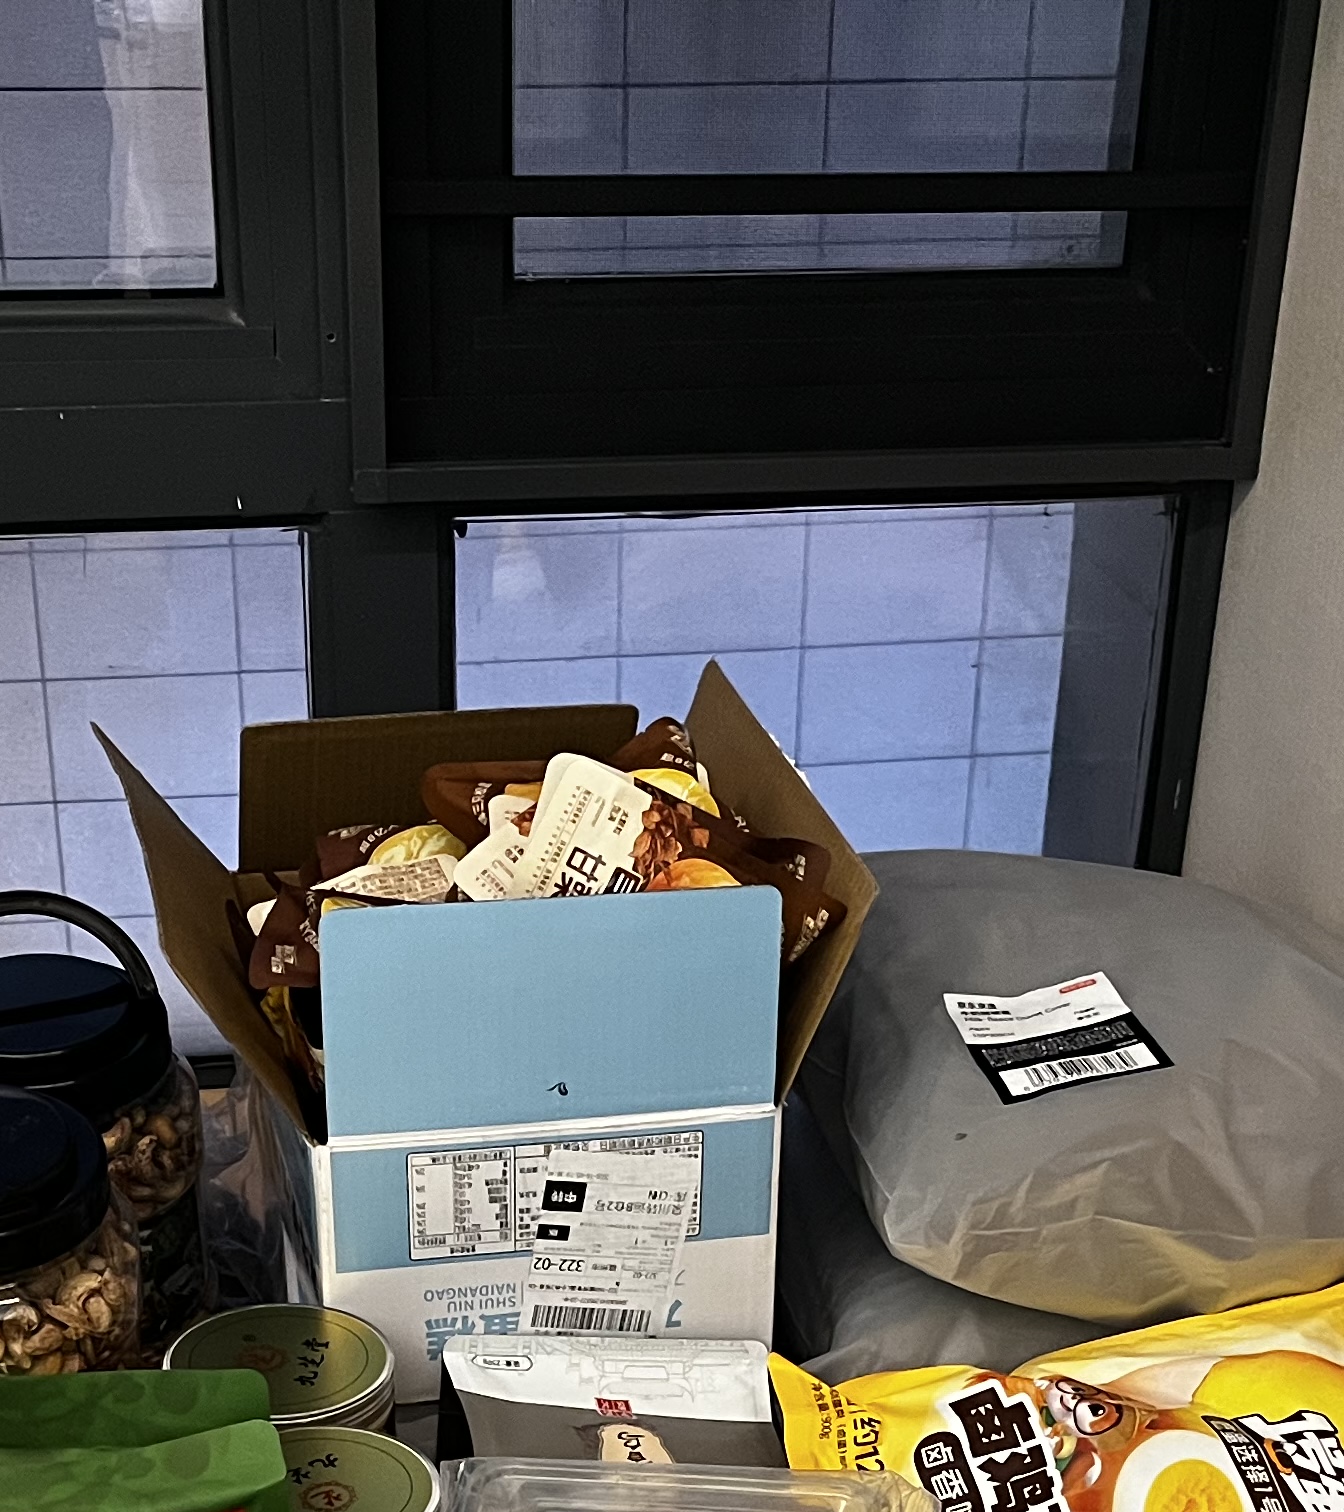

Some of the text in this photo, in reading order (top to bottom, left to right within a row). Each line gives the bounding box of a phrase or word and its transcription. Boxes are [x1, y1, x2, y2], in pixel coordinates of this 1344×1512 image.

[533, 1256, 586, 1272] 322-02
[424, 1283, 516, 1302] NAIDANGAO
[447, 1297, 517, 1313] SHUI NIU
[293, 1337, 332, 1388] 九芝堂
